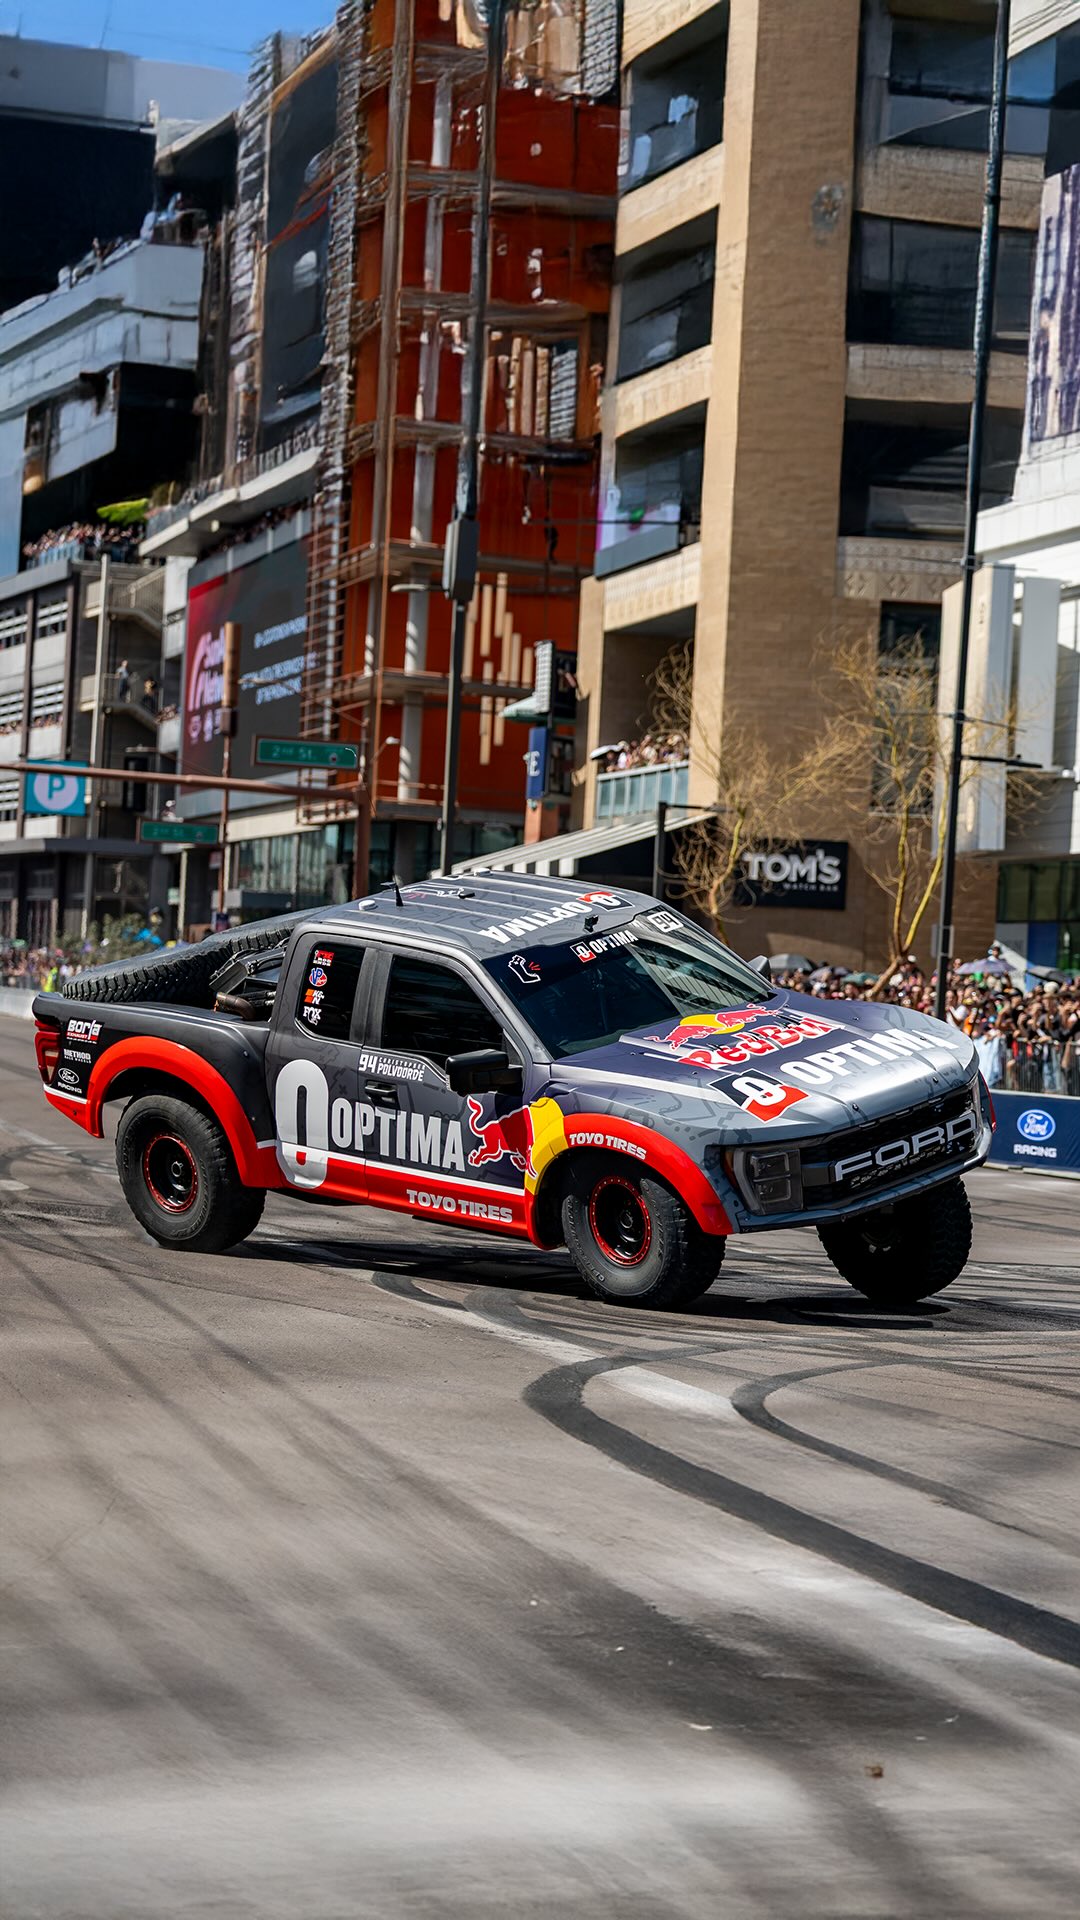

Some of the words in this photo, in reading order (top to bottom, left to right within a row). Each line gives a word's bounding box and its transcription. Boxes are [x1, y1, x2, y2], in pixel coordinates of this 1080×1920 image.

[48, 772, 65, 799] P
[742, 849, 841, 885] TOM'S
[477, 901, 593, 944] OPTIMA
[588, 929, 640, 954] OPTIMA
[303, 1006, 322, 1026] FOX
[358, 1053, 378, 1074] 94
[377, 1063, 424, 1082] POLVOORDE
[331, 1097, 466, 1172] OPTIMA
[569, 1132, 604, 1145] TOYO
[605, 1134, 647, 1160] TIRES
[834, 1112, 977, 1182] FORD
[1013, 1143, 1057, 1158] RACING
[406, 1188, 456, 1213] TOYO
[458, 1199, 513, 1224] TIRES
